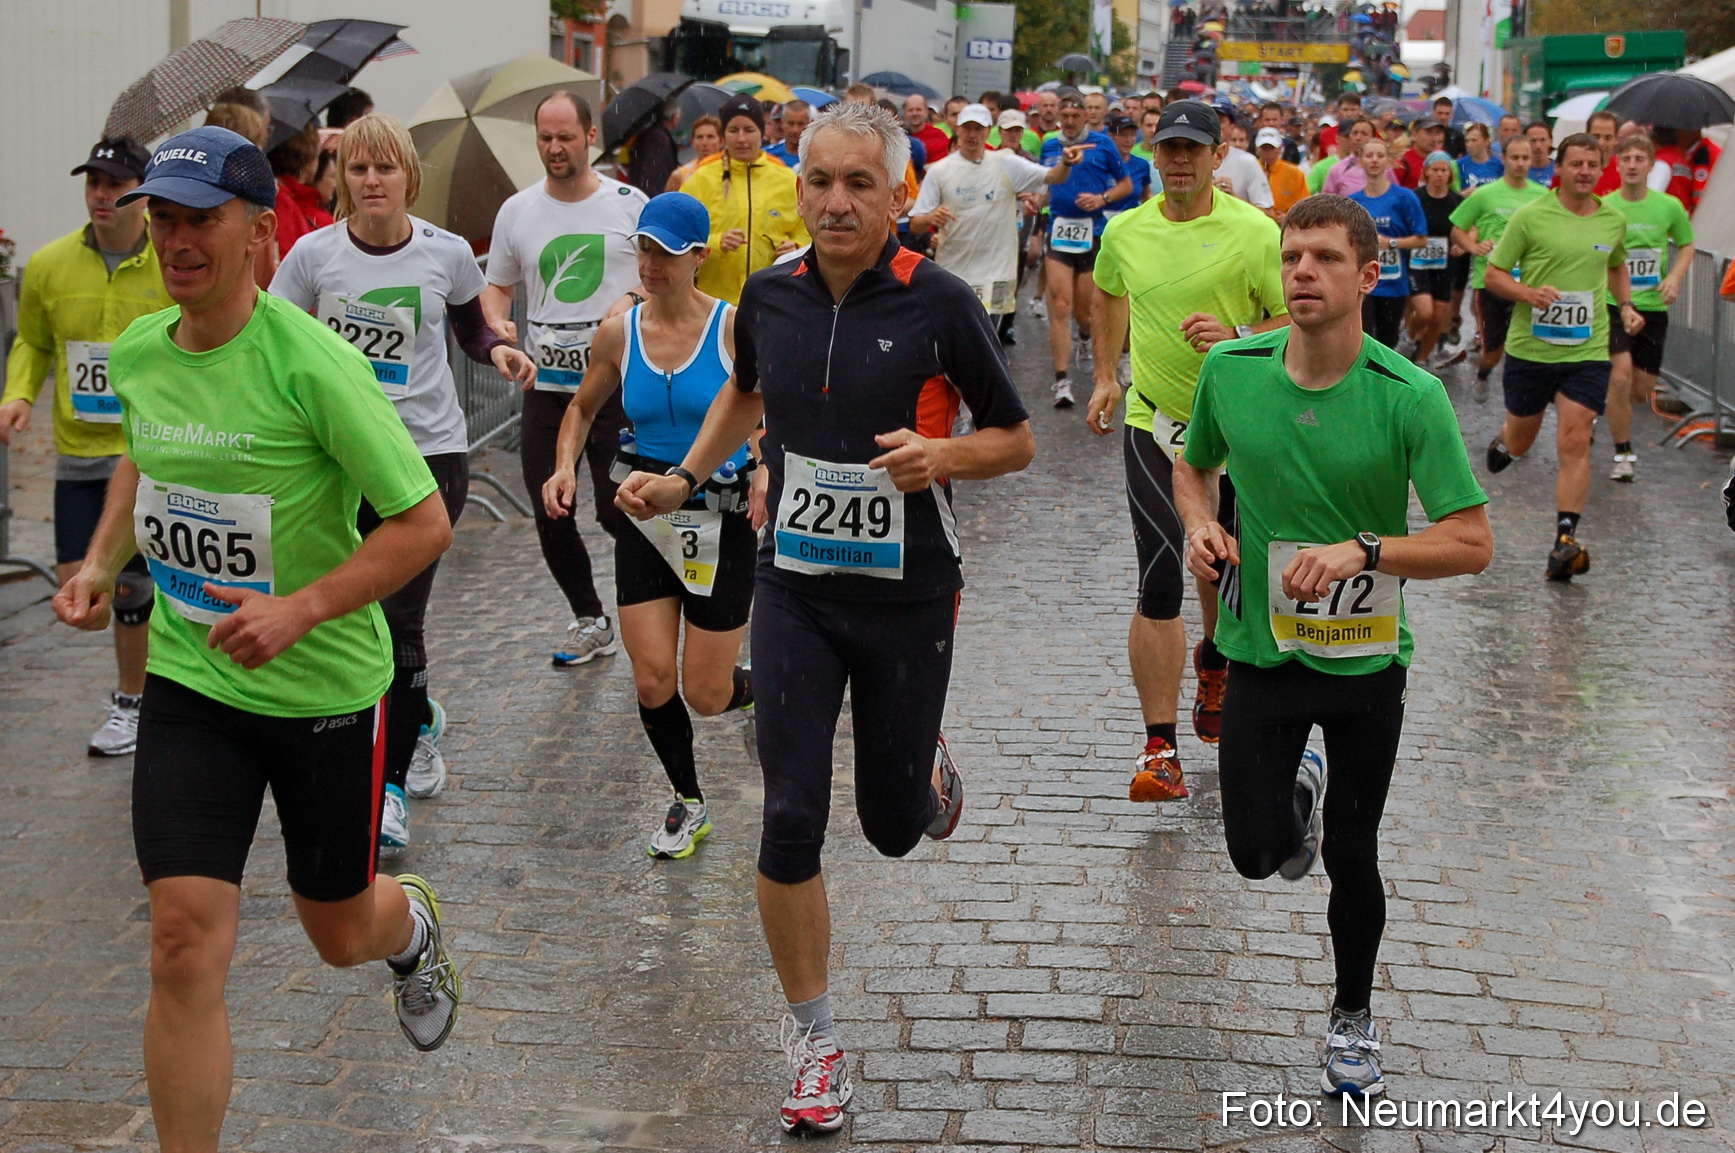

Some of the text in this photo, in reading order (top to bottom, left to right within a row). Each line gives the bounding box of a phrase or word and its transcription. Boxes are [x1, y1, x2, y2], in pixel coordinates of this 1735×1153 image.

[718, 1, 791, 18] BOCK
[1261, 45, 1304, 57] START
[1056, 225, 1089, 241] 2427
[346, 304, 386, 321] BOCK
[1538, 306, 1588, 325] 2210
[76, 363, 108, 393] 26
[1169, 421, 1188, 446] 2
[815, 468, 865, 485] BOCK
[167, 493, 220, 515] BOCK
[787, 487, 892, 540] 2249
[144, 515, 257, 578] 3065
[800, 541, 873, 564] Chrsitian
[1296, 623, 1372, 645] Benjamin
[327, 714, 358, 729] asics
